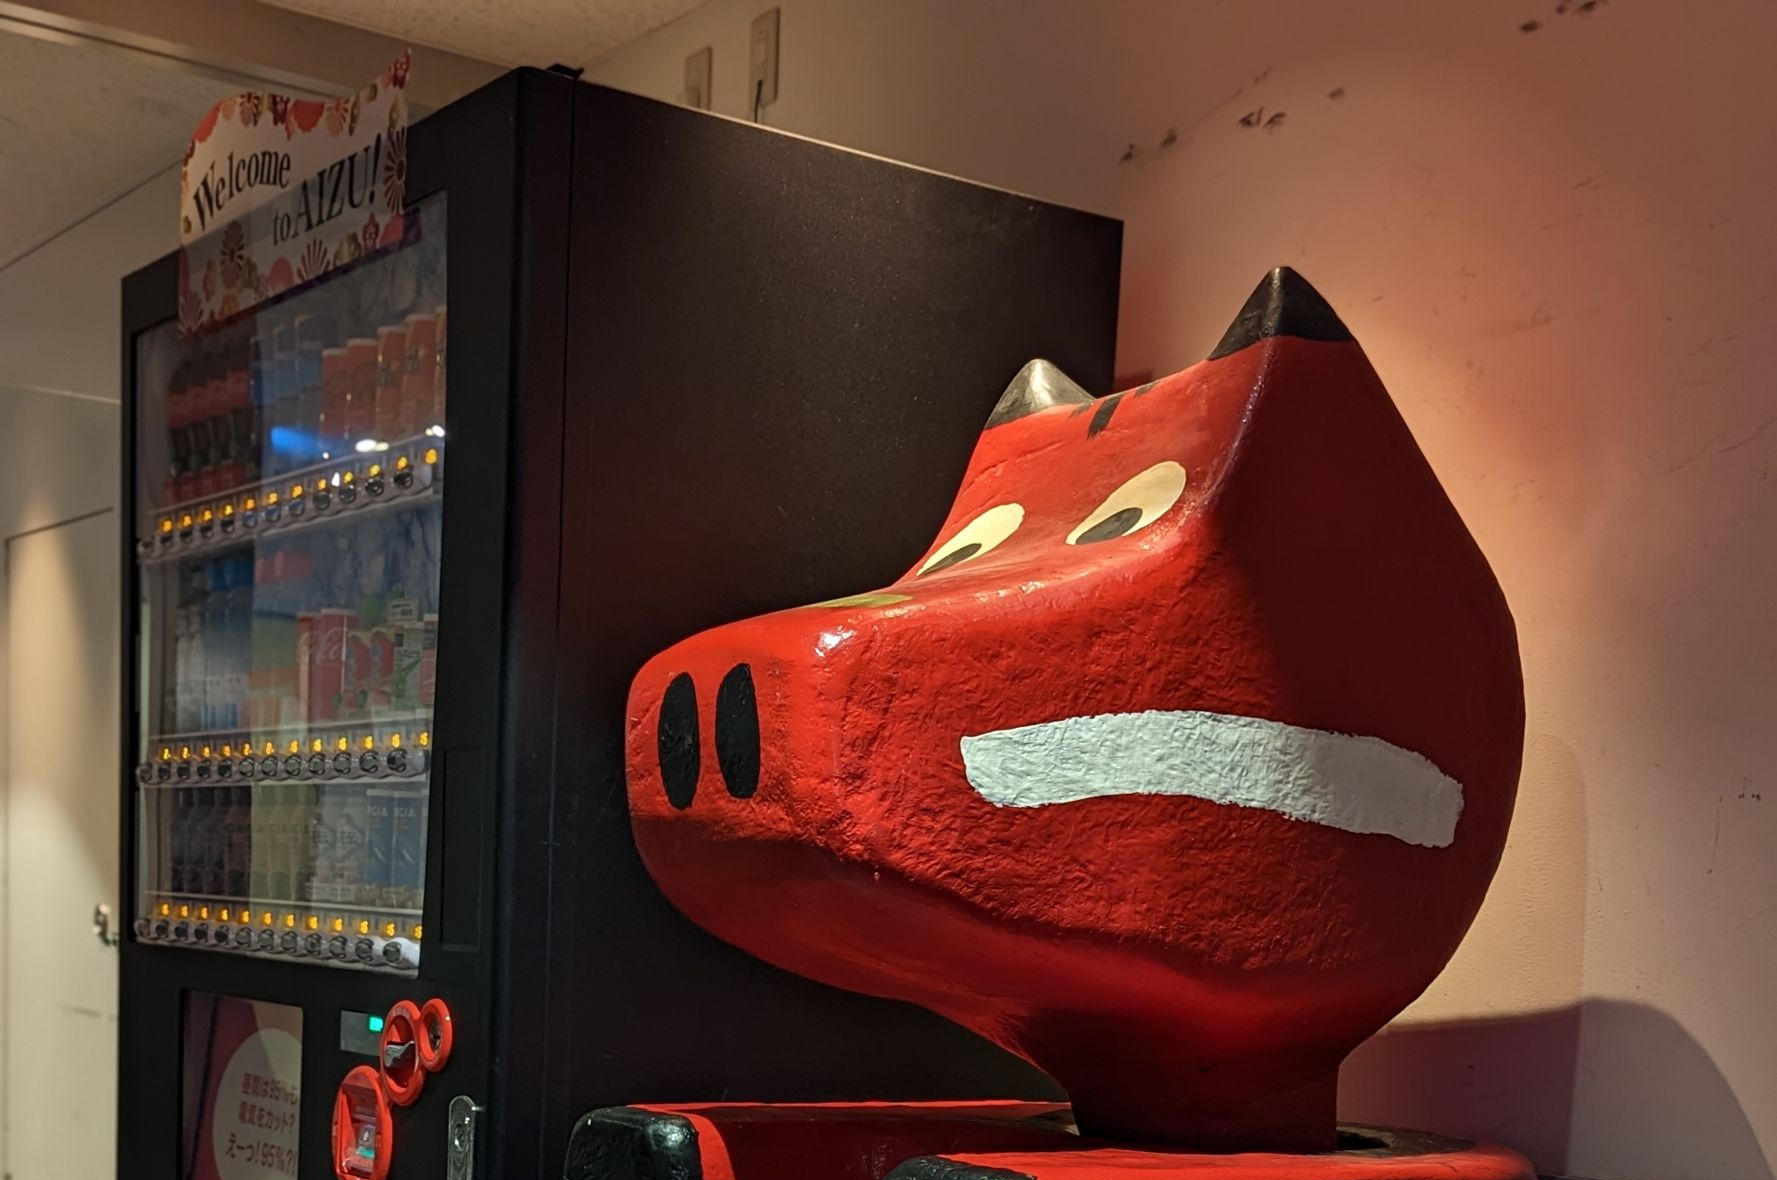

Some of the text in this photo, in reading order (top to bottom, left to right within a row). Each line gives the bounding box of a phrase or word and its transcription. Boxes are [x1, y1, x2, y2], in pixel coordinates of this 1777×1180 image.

[193, 149, 291, 231] Welcome
[273, 132, 382, 245] to AIZU!
